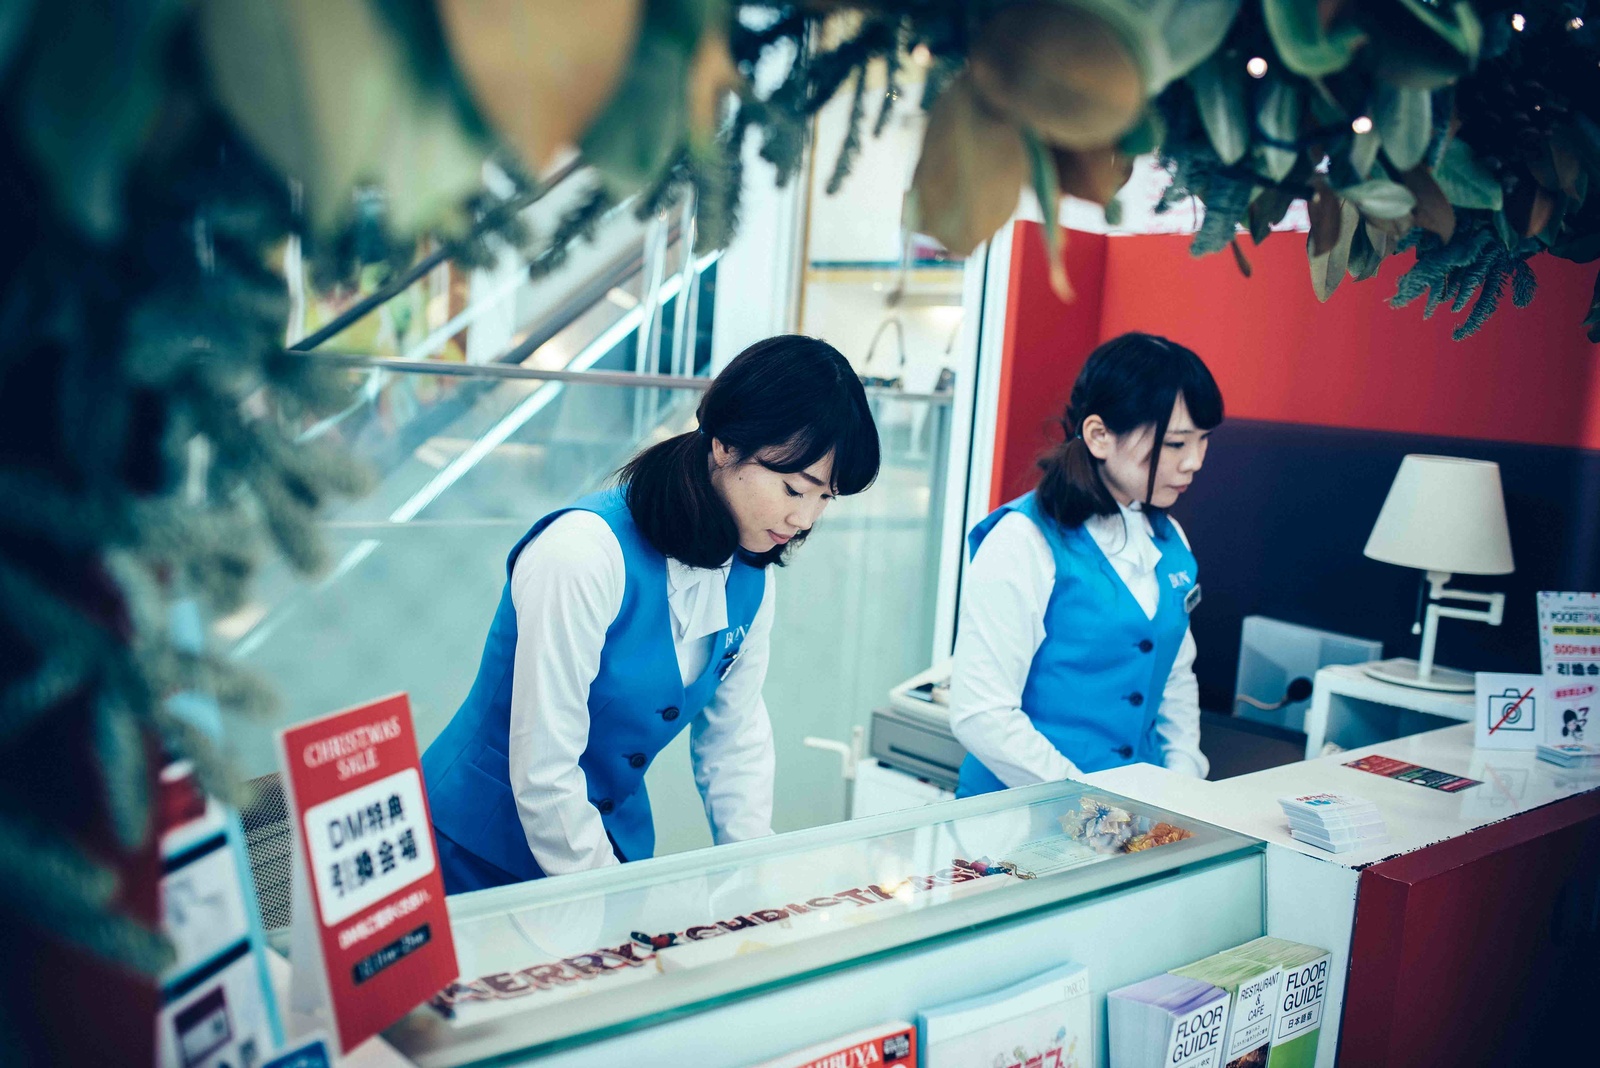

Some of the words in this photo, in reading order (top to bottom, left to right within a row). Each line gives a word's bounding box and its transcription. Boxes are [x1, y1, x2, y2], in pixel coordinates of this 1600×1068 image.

[303, 715, 401, 768] CHRISTMAS
[336, 746, 379, 780] SALE
[1240, 971, 1280, 1002] RESTAURANT
[1286, 960, 1327, 992] FLOOR
[1255, 993, 1261, 1005] &
[1283, 980, 1325, 1012] GUIDE
[1176, 1005, 1223, 1042] FLOOR
[1288, 1010, 1313, 1029] 日本語版
[1173, 1026, 1220, 1063] GUIDE
